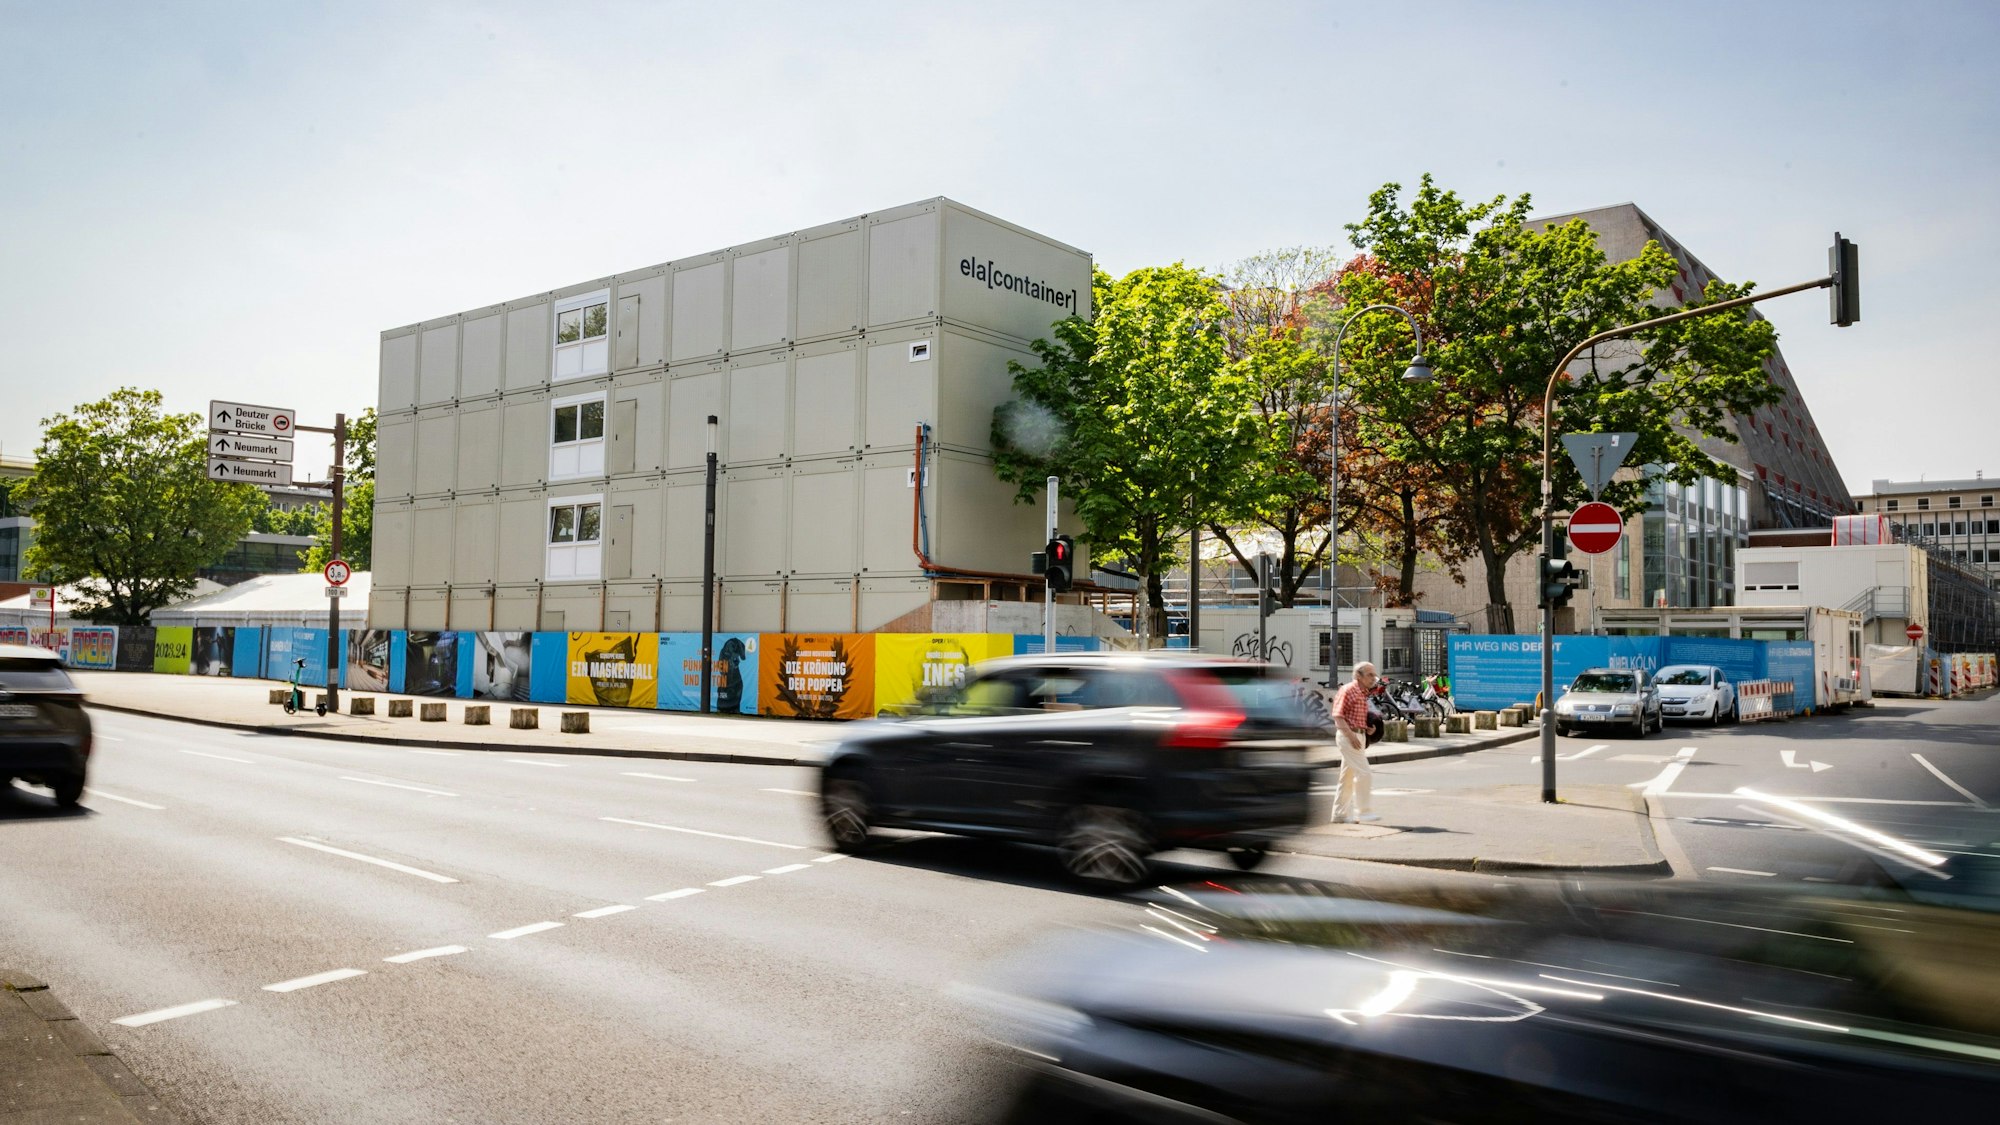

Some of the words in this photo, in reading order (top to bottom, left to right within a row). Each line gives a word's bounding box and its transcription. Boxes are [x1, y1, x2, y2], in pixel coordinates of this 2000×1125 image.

[960, 256, 1077, 316] ela[container]
[236, 407, 269, 420] Deutzer
[235, 419, 266, 431] Brücke
[234, 442, 278, 455] Neumarkt
[233, 465, 277, 479] Heumarkt
[155, 642, 187, 659] 2023.24
[1454, 641, 1472, 651] IHR
[1474, 641, 1499, 652] WEG
[1501, 642, 1519, 652] INS
[785, 660, 802, 675] DIE
[803, 658, 847, 676] KRÖNUNG
[1630, 653, 1657, 670] KÖLN
[571, 661, 588, 677] EIN
[590, 662, 653, 680] MASKENBALL
[922, 663, 966, 690] INES
[684, 674, 700, 687] UND
[788, 677, 806, 691] DER
[807, 678, 843, 692] POPPEA
